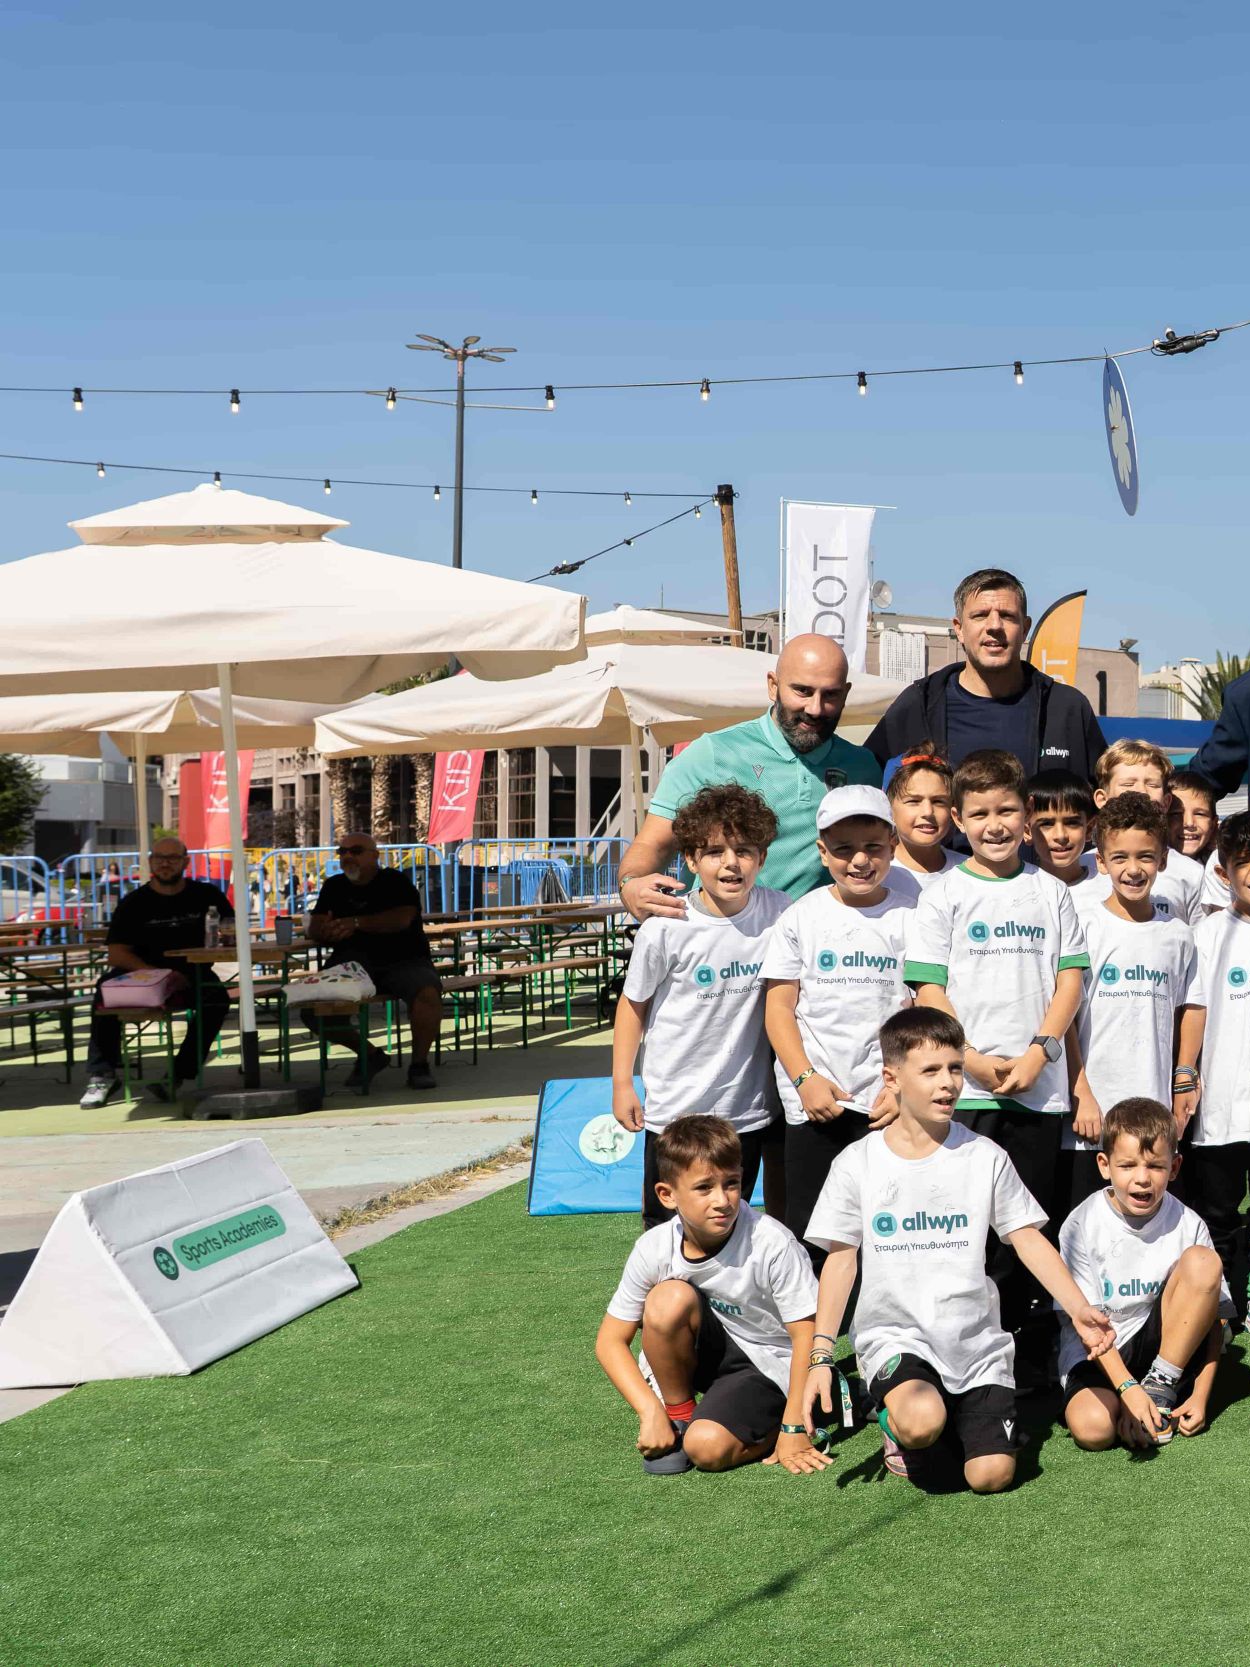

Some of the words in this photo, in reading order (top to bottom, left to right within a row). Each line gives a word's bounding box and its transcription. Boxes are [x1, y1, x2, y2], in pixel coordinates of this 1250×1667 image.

[1045, 746, 1070, 759] allwyn
[438, 750, 472, 811] KID
[993, 920, 1046, 942] allwyn
[841, 950, 898, 973] allwyn
[1124, 964, 1169, 987] allwyn
[902, 1211, 968, 1234] allwyn
[180, 1234, 222, 1265] Sports
[219, 1215, 279, 1248] Academies
[874, 1243, 910, 1253] Εταιρική
[910, 1240, 969, 1251] Υπευθυνότητα
